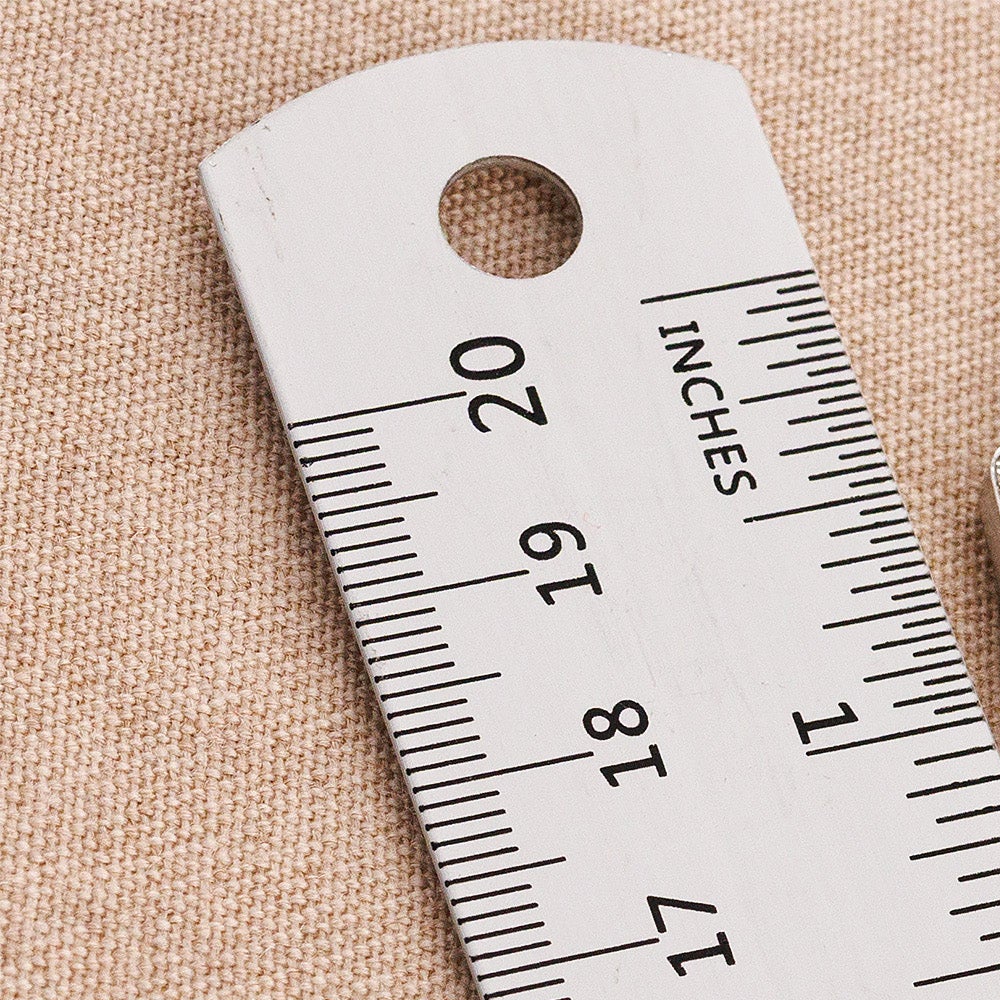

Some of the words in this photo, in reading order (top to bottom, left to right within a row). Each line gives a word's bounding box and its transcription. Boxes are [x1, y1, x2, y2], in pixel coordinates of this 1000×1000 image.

[450, 337, 548, 433] 20
[659, 321, 757, 495] INCHES
[519, 522, 602, 605] 19
[583, 700, 667, 787] 18
[792, 702, 858, 744] 1
[647, 896, 735, 976] 17
